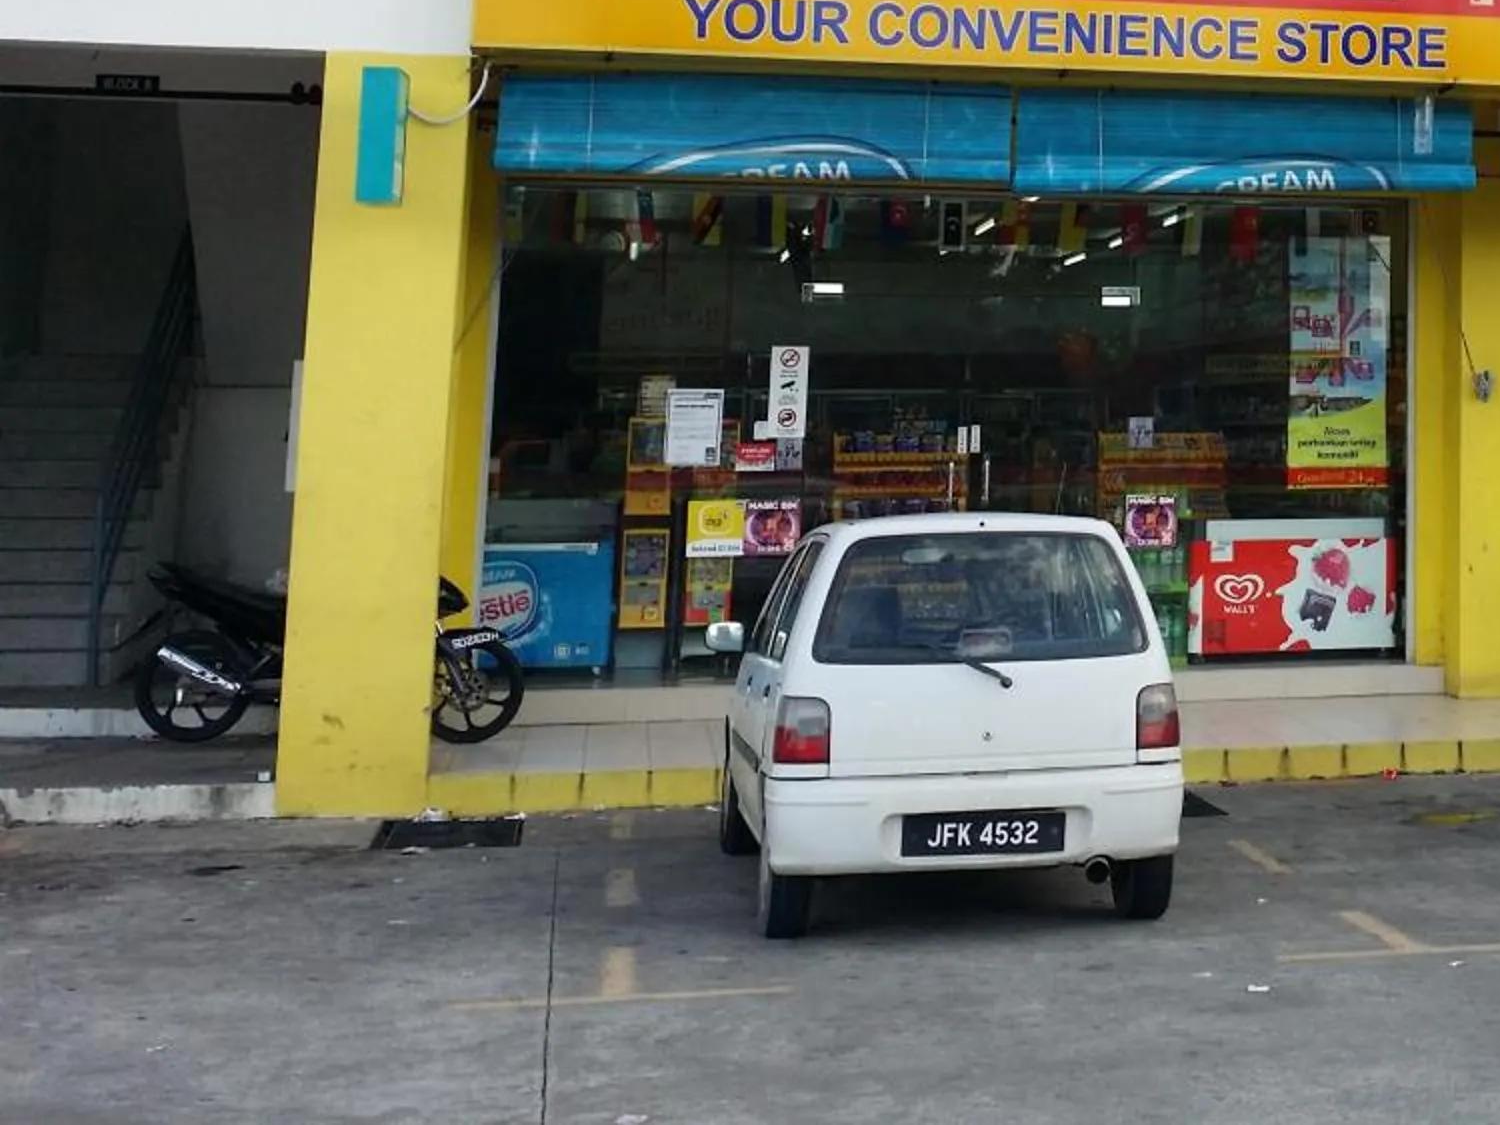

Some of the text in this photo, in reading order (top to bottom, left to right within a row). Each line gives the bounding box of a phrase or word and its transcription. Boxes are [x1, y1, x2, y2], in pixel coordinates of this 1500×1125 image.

[868, 2, 1259, 61] CONVENIENCE
[1276, 21, 1447, 69] STORE
[927, 819, 1039, 848] JFK 4532
